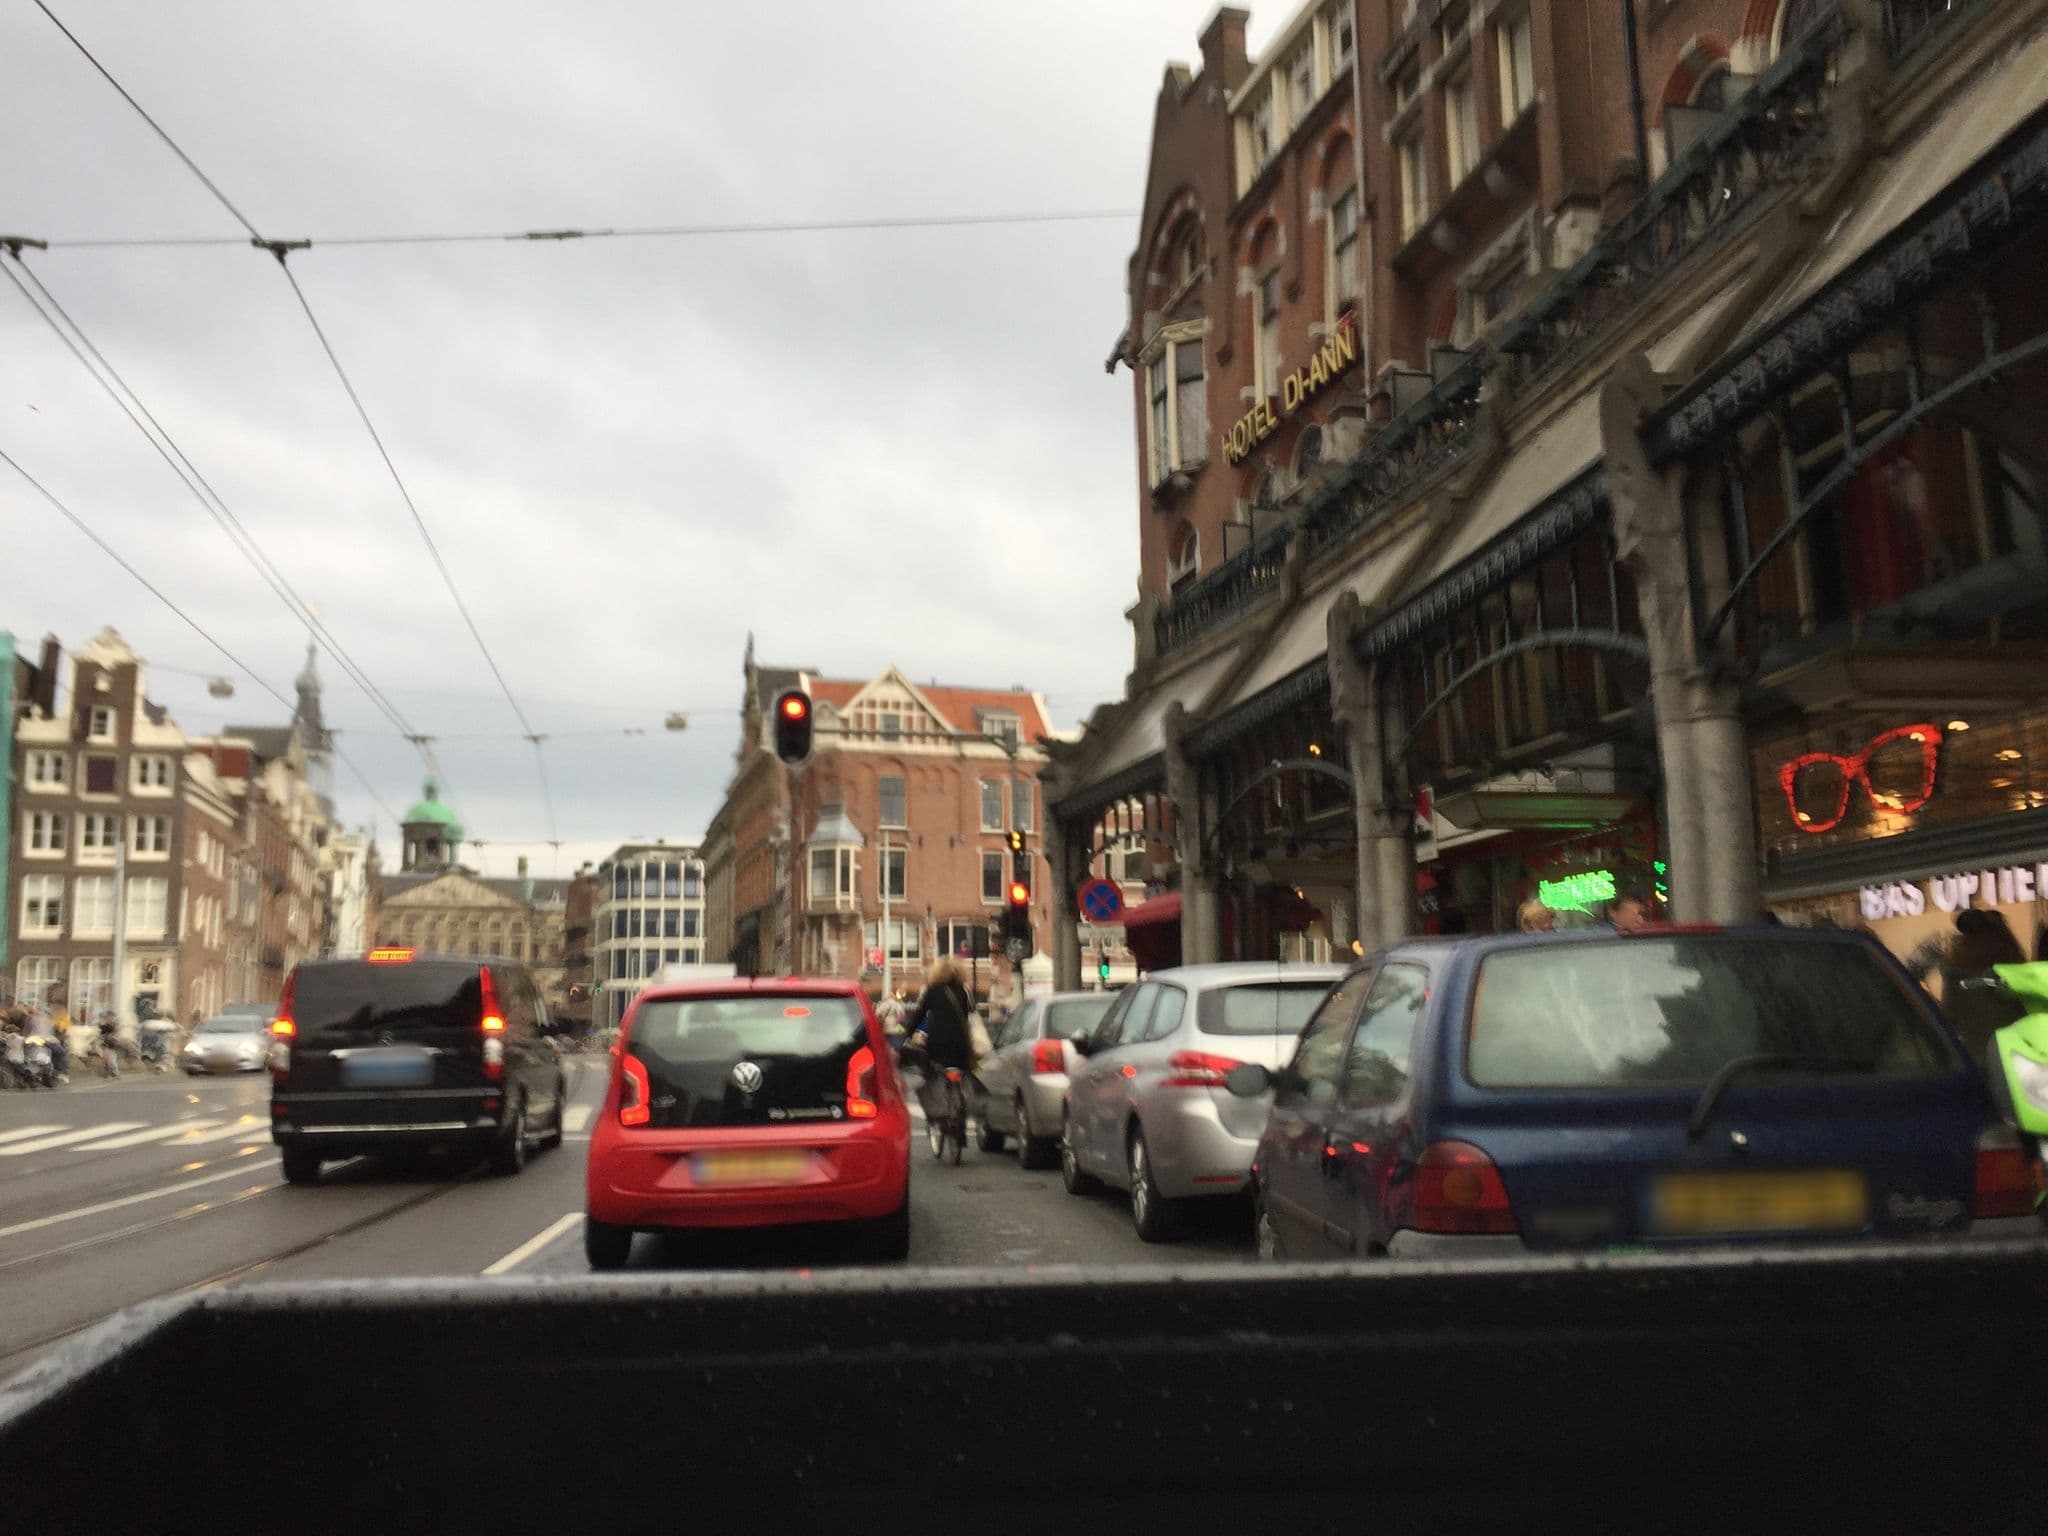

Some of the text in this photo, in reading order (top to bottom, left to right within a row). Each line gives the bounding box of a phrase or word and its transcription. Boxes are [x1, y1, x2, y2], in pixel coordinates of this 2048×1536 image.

[1221, 325, 1355, 467] HOTEL DI-ANN
[1860, 879, 1925, 920] BAS
